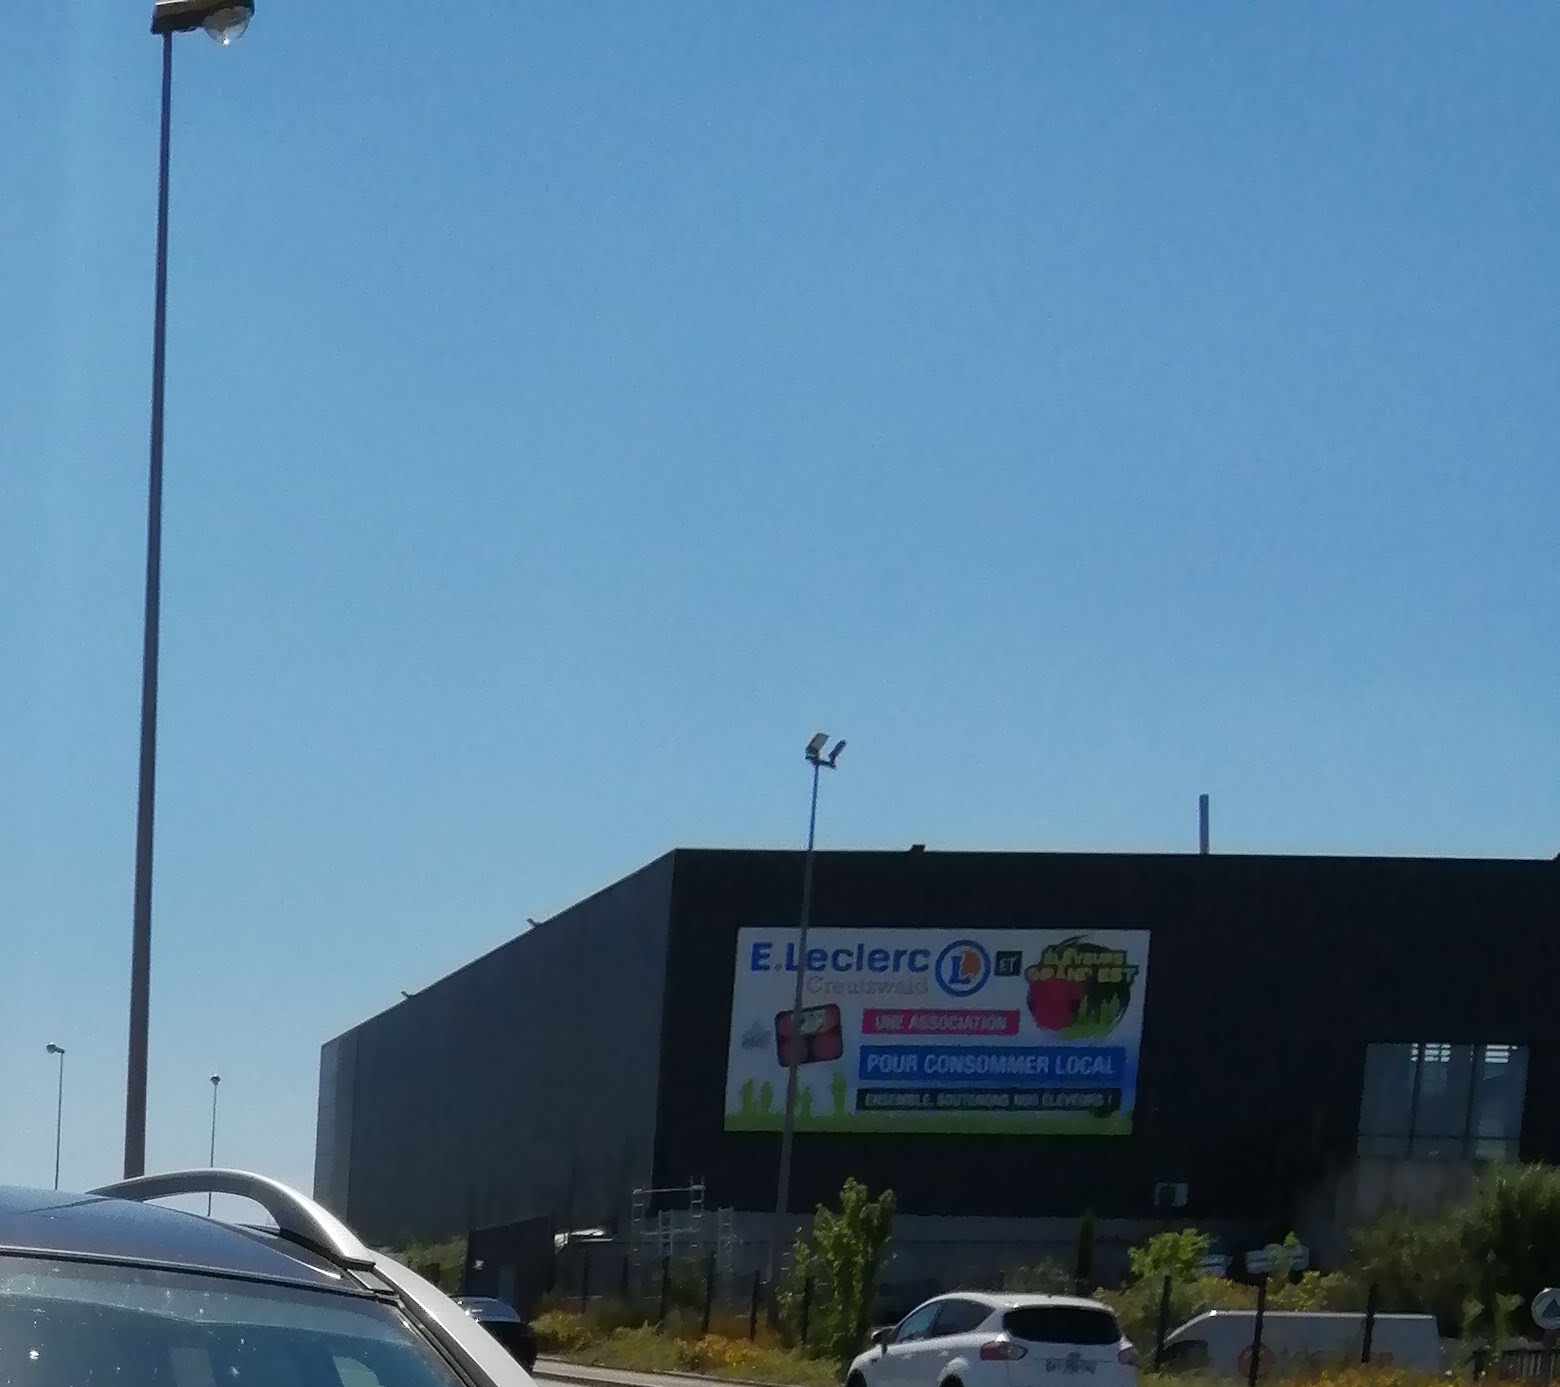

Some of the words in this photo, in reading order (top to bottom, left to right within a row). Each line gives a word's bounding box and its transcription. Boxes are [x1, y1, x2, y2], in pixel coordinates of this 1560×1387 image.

[751, 942, 930, 972] E.Leclerc
[876, 1014, 904, 1029] UNE
[908, 1014, 1007, 1031] ASSOCIATION
[867, 1055, 918, 1073] POUR
[923, 1054, 1048, 1074] CONSOMMER
[1055, 1056, 1116, 1074] LOCAL
